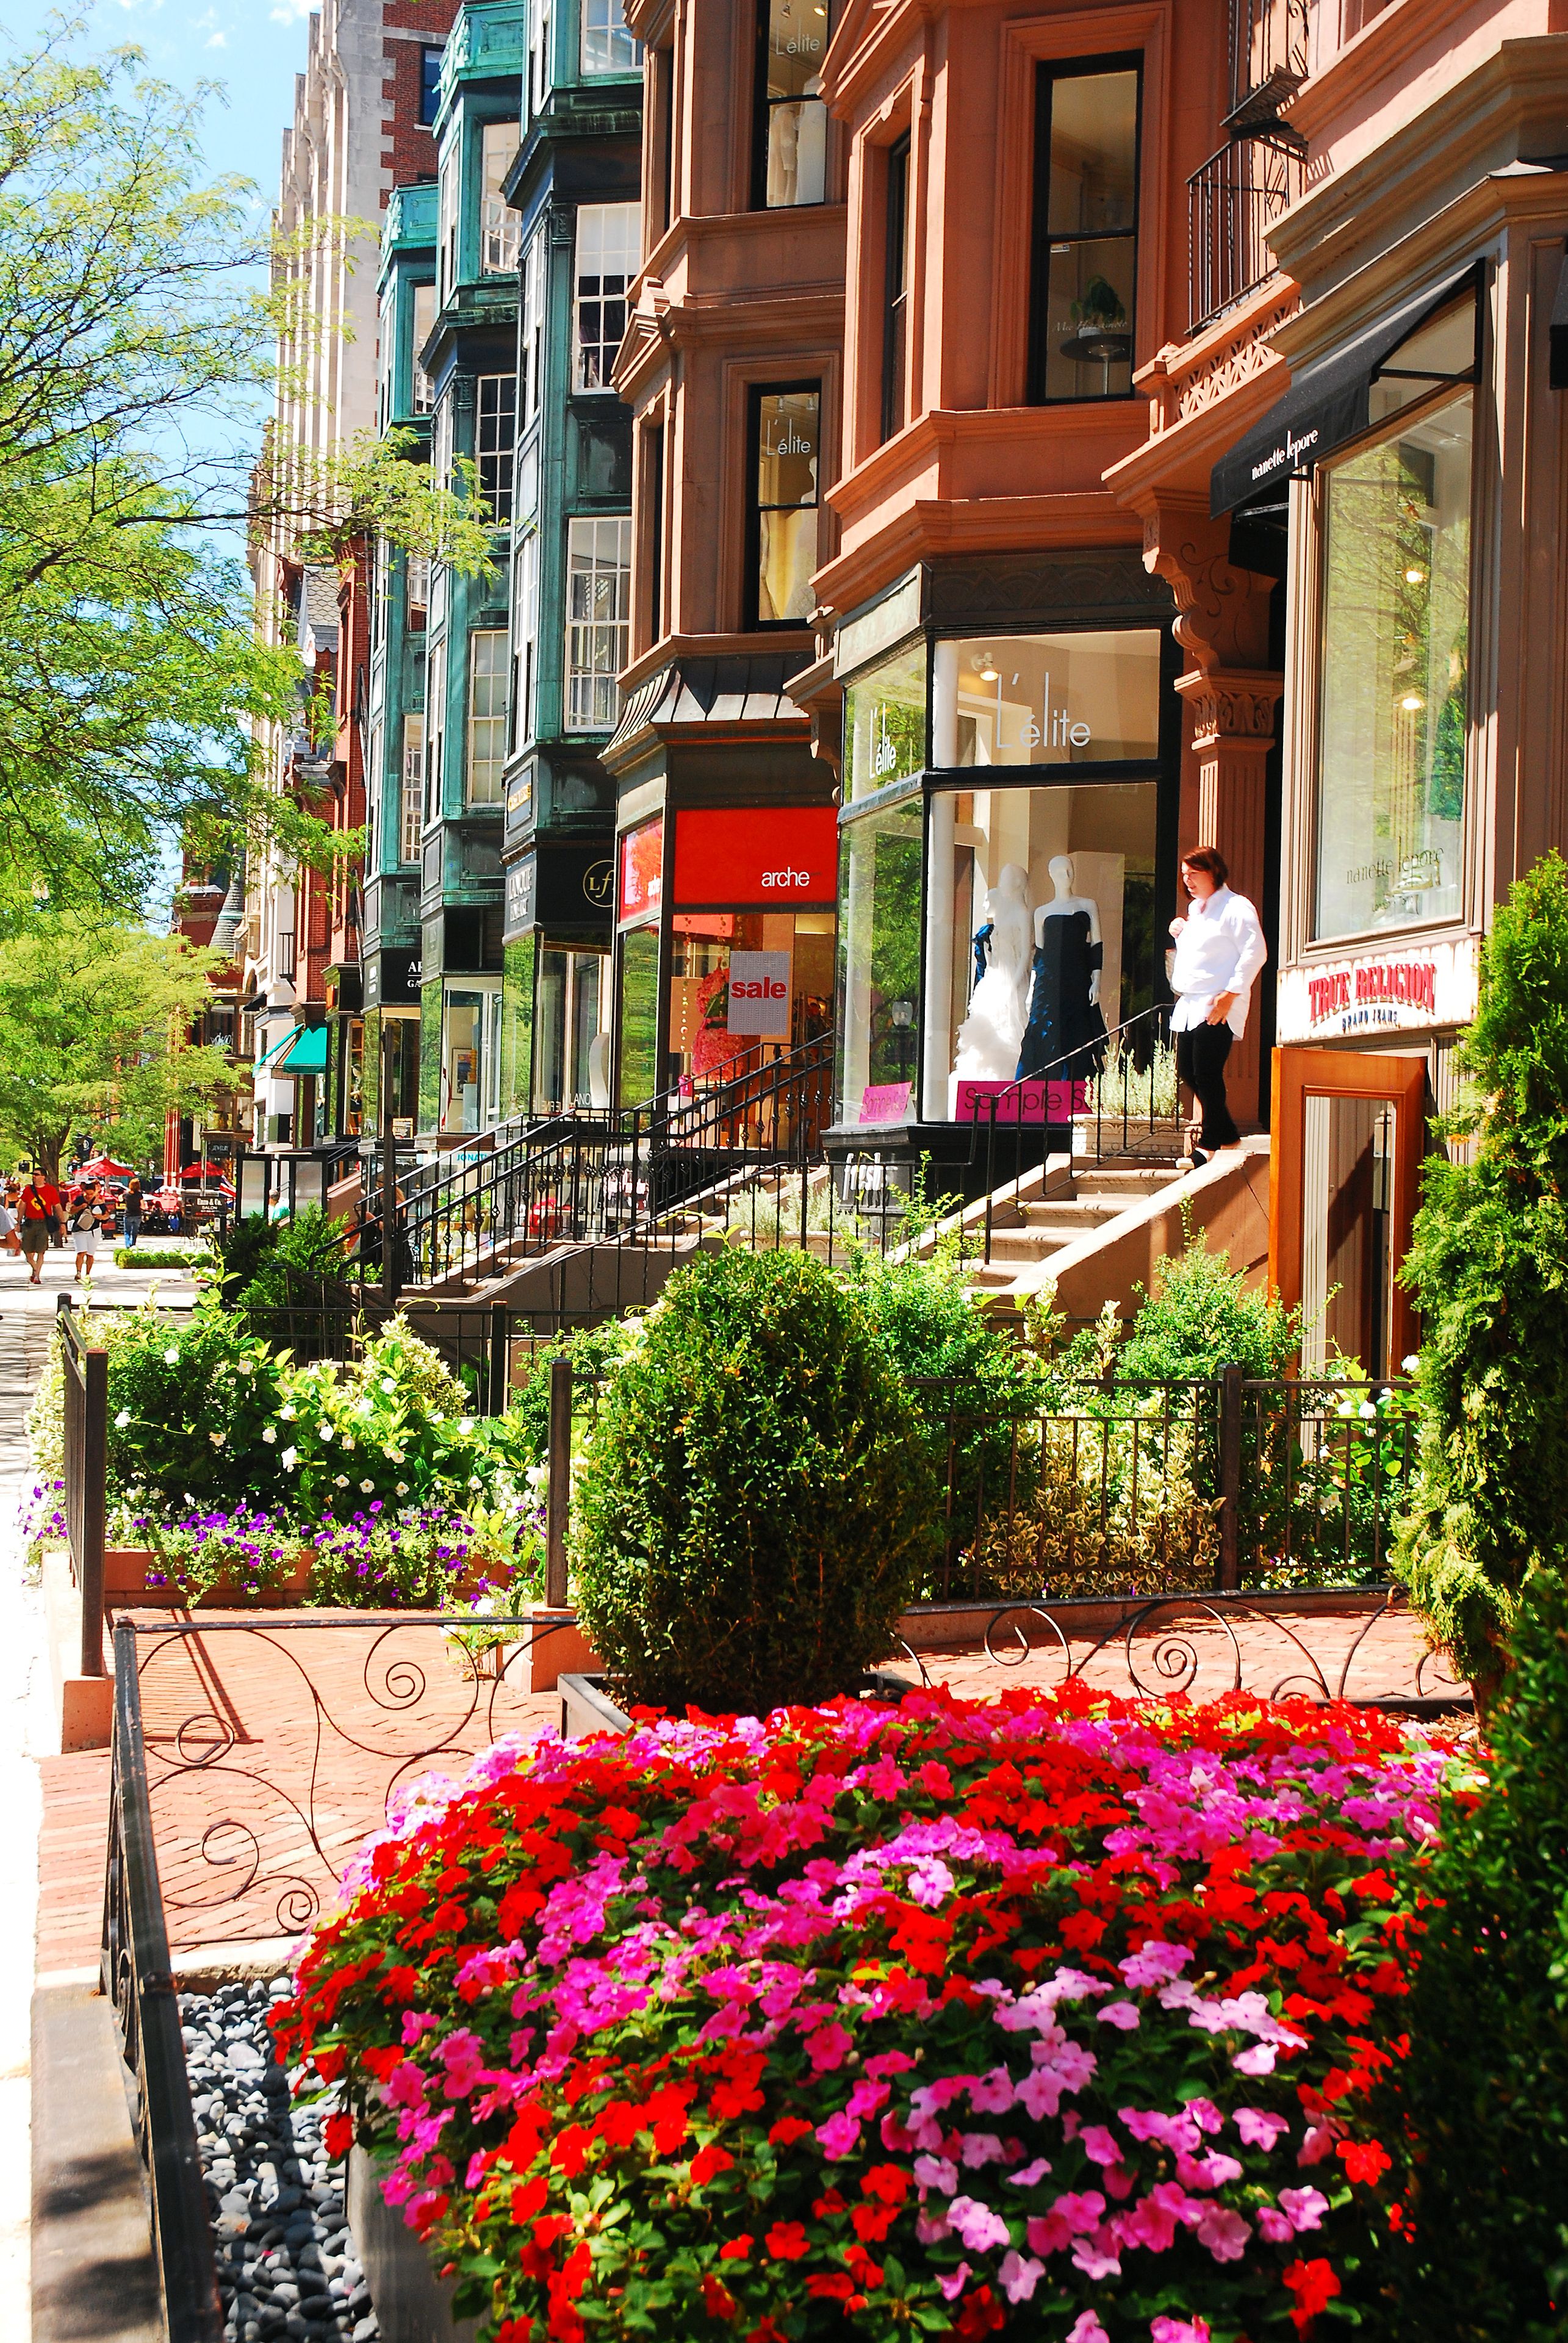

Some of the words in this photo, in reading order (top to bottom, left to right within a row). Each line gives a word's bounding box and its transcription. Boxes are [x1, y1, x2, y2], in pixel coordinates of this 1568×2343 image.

[1251, 447, 1286, 480] nanette
[1286, 430, 1318, 467] lepore
[996, 672, 1091, 749] L'élite
[761, 866, 810, 887] arche
[1347, 858, 1394, 884] nanette
[731, 976, 786, 999] sale
[1308, 971, 1350, 1023] TRUE
[1355, 963, 1435, 1014] RELIGION
